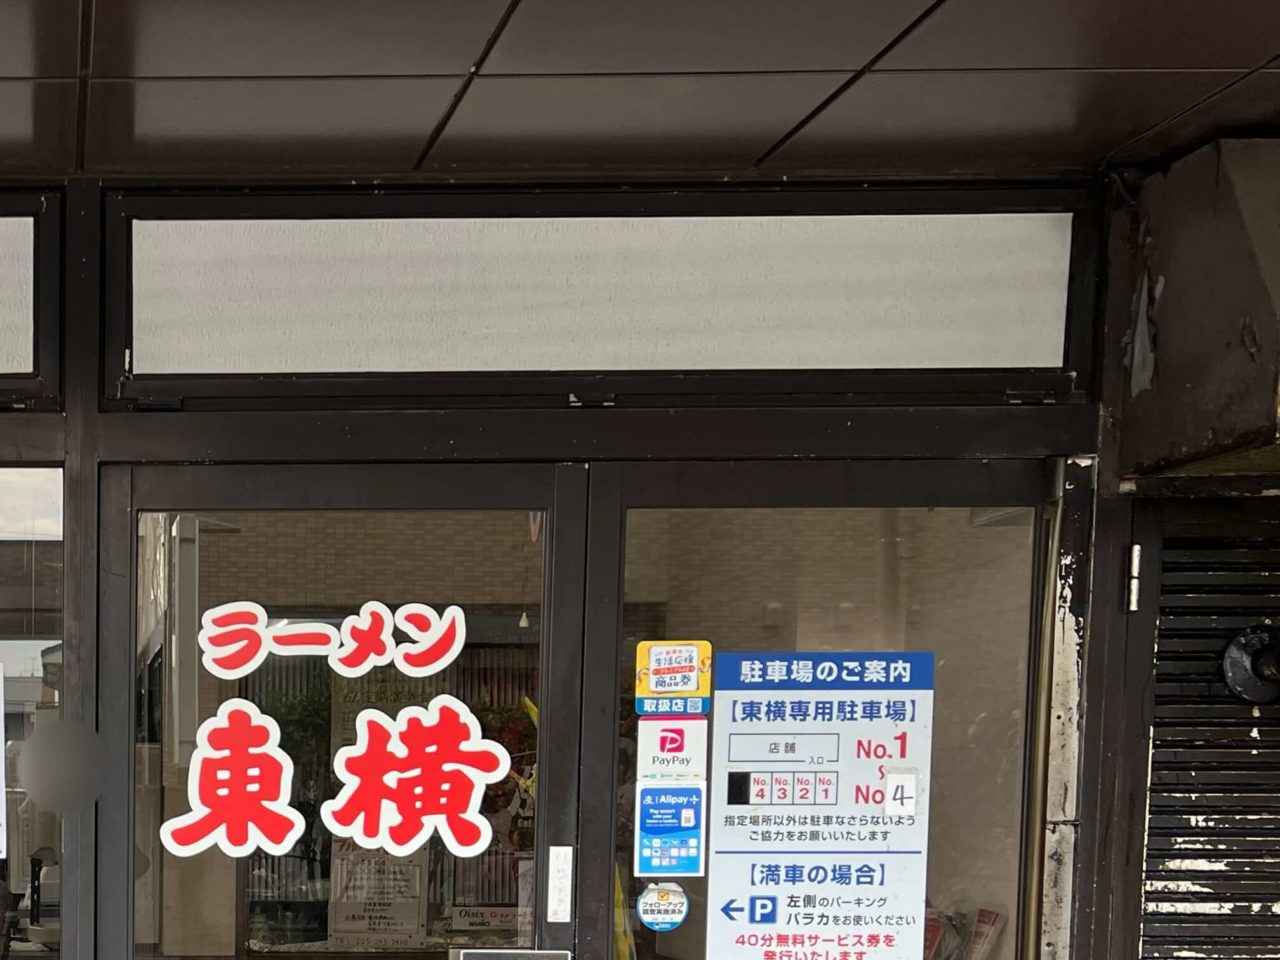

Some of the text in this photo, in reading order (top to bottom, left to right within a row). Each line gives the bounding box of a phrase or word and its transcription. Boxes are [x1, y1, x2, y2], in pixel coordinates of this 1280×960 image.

[208, 610, 457, 669] ラーメン
[740, 660, 912, 683] 駐車場のご案内
[643, 698, 685, 712] 取扱店
[730, 699, 918, 723] 【東横専用駐車場】
[768, 742, 797, 755] 店舗
[857, 732, 908, 760] No.1
[652, 756, 692, 767] PayPay
[808, 756, 824, 765] 入口
[171, 706, 500, 846] 東横
[724, 814, 916, 828] 指定場所以外は駐車なさらないよう
[749, 829, 891, 842] ご協力をお願いいたします
[748, 864, 887, 886] 【満車の場合】
[786, 894, 888, 908] 左側のパーキング
[735, 934, 896, 948] 40分無料サービス券を
